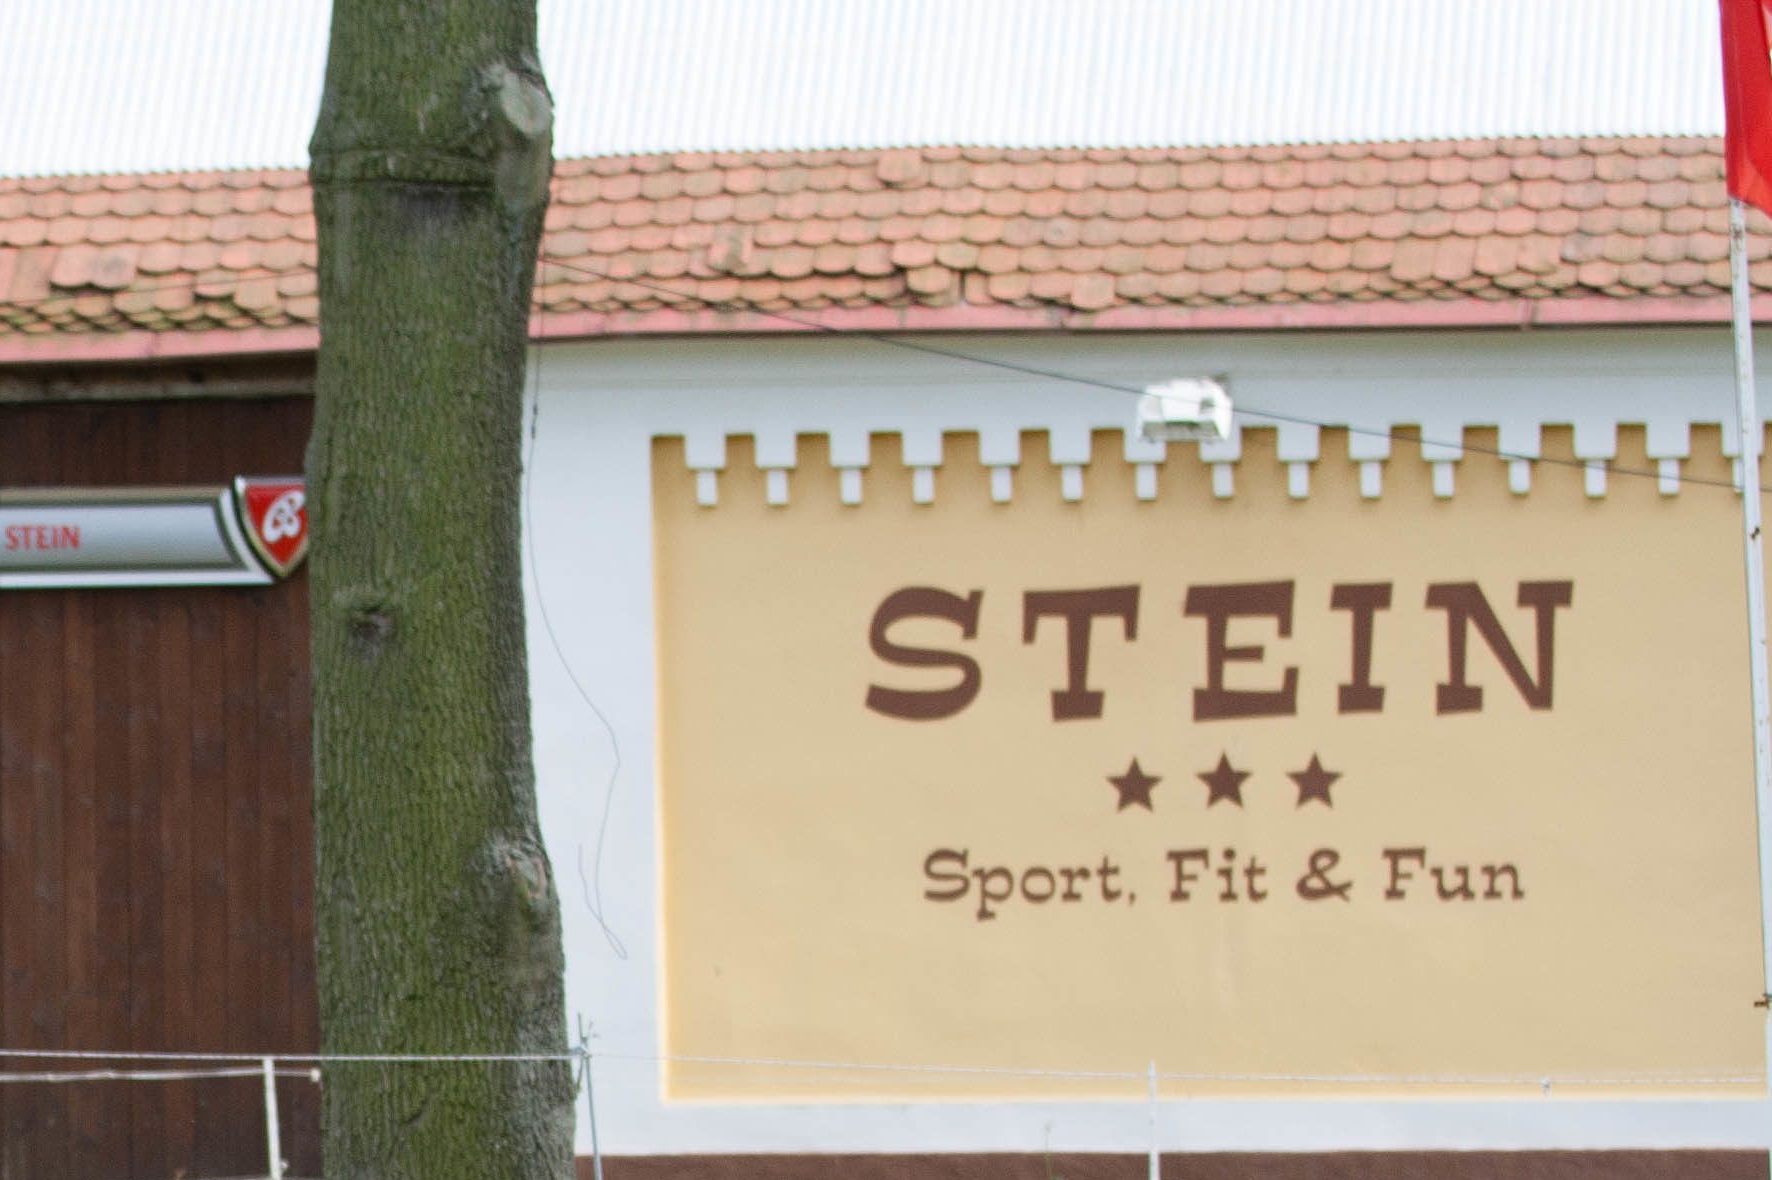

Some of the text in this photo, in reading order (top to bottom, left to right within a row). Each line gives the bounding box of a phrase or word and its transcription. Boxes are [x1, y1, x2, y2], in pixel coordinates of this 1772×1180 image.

[4, 525, 81, 550] STEIN
[865, 578, 1575, 723] STEIN
[923, 847, 1526, 921] Sport, Fit & Fun
